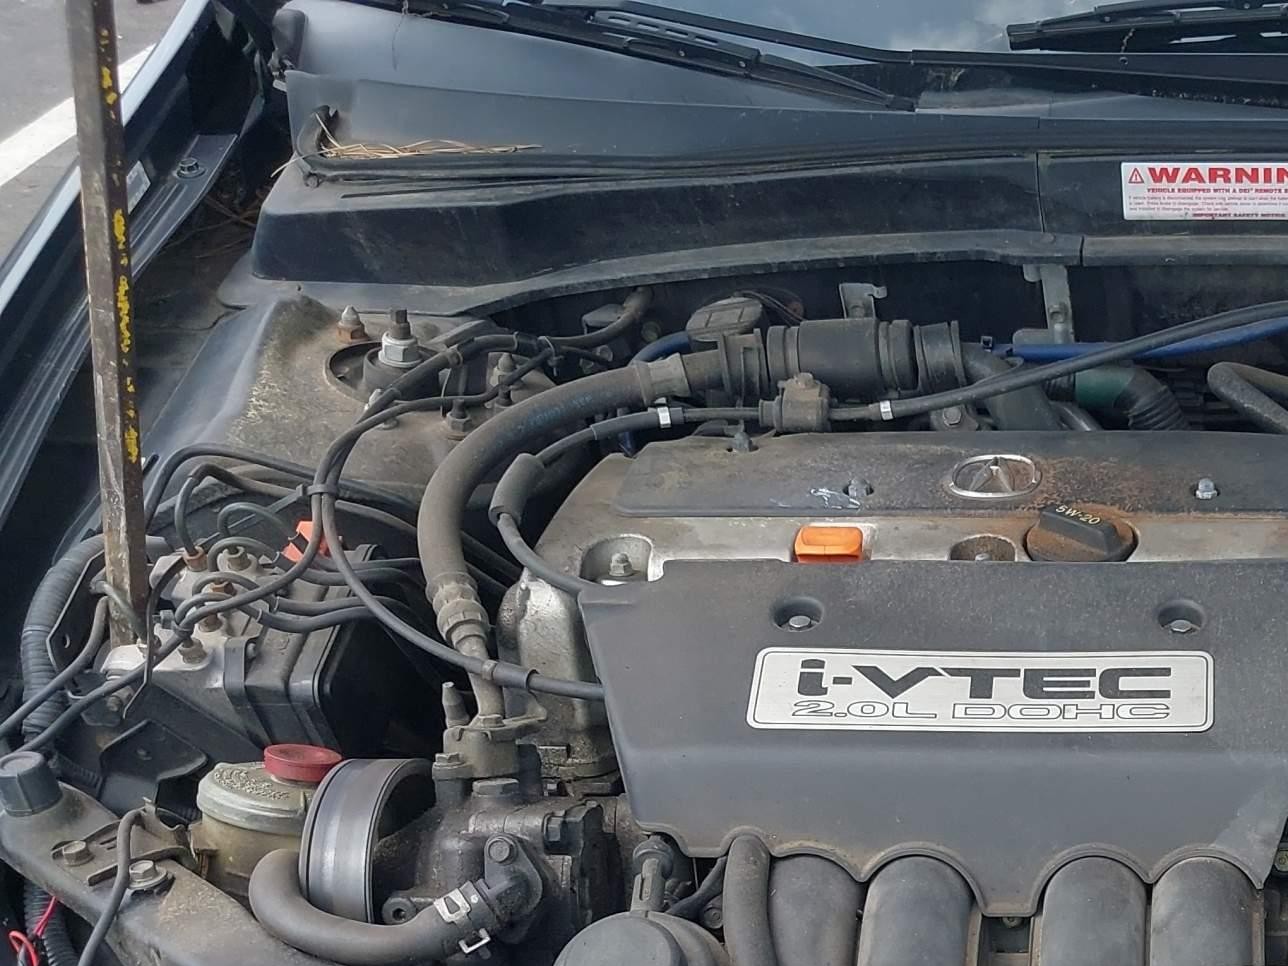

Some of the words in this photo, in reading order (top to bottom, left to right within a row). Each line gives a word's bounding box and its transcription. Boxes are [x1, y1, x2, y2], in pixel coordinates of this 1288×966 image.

[1056, 505, 1101, 525] 5W-20
[796, 658, 1172, 700] i-VTEC
[791, 699, 937, 719] 2.0L
[952, 702, 1171, 720] DOHC
